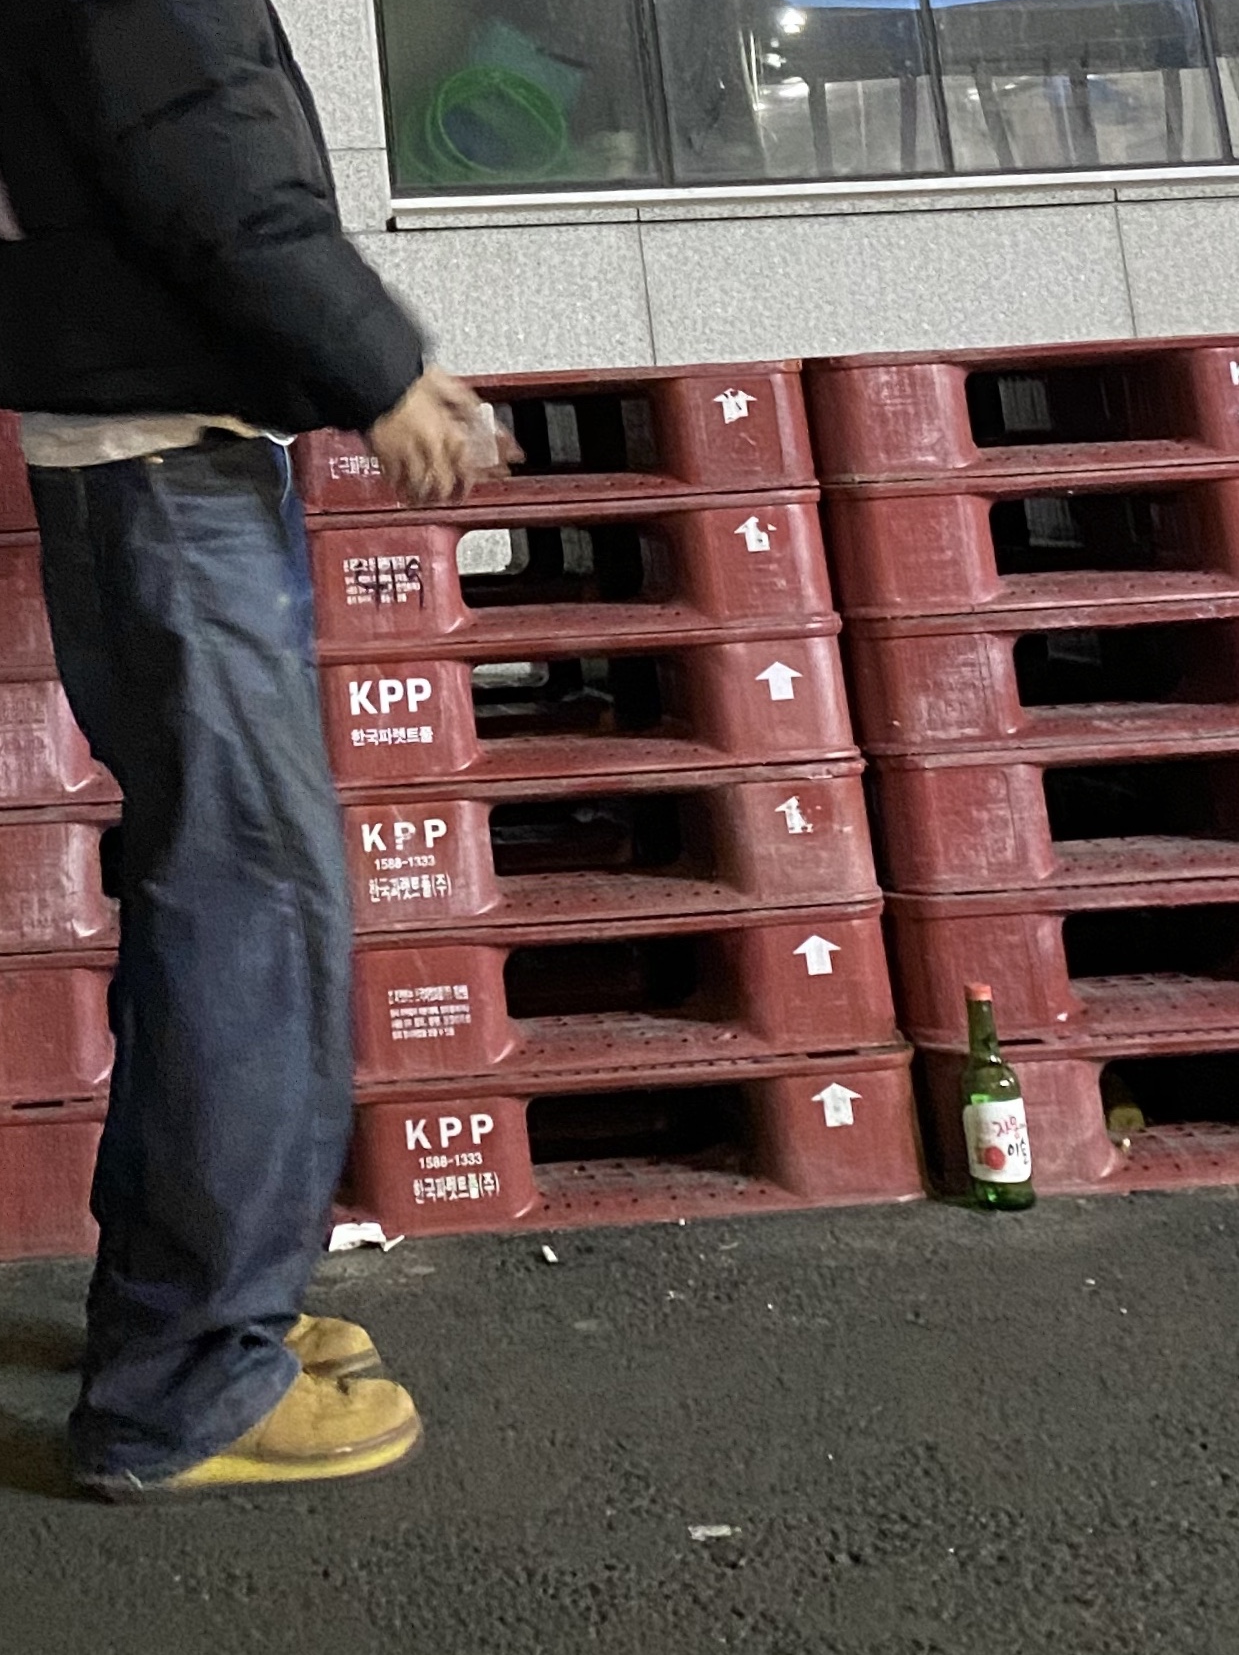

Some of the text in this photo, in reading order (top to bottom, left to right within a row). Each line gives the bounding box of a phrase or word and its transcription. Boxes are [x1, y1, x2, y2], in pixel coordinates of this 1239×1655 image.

[348, 678, 433, 716] KPP
[351, 726, 434, 746] 한국파렛트풀
[361, 818, 449, 853] KPP
[405, 1114, 495, 1151] KPP
